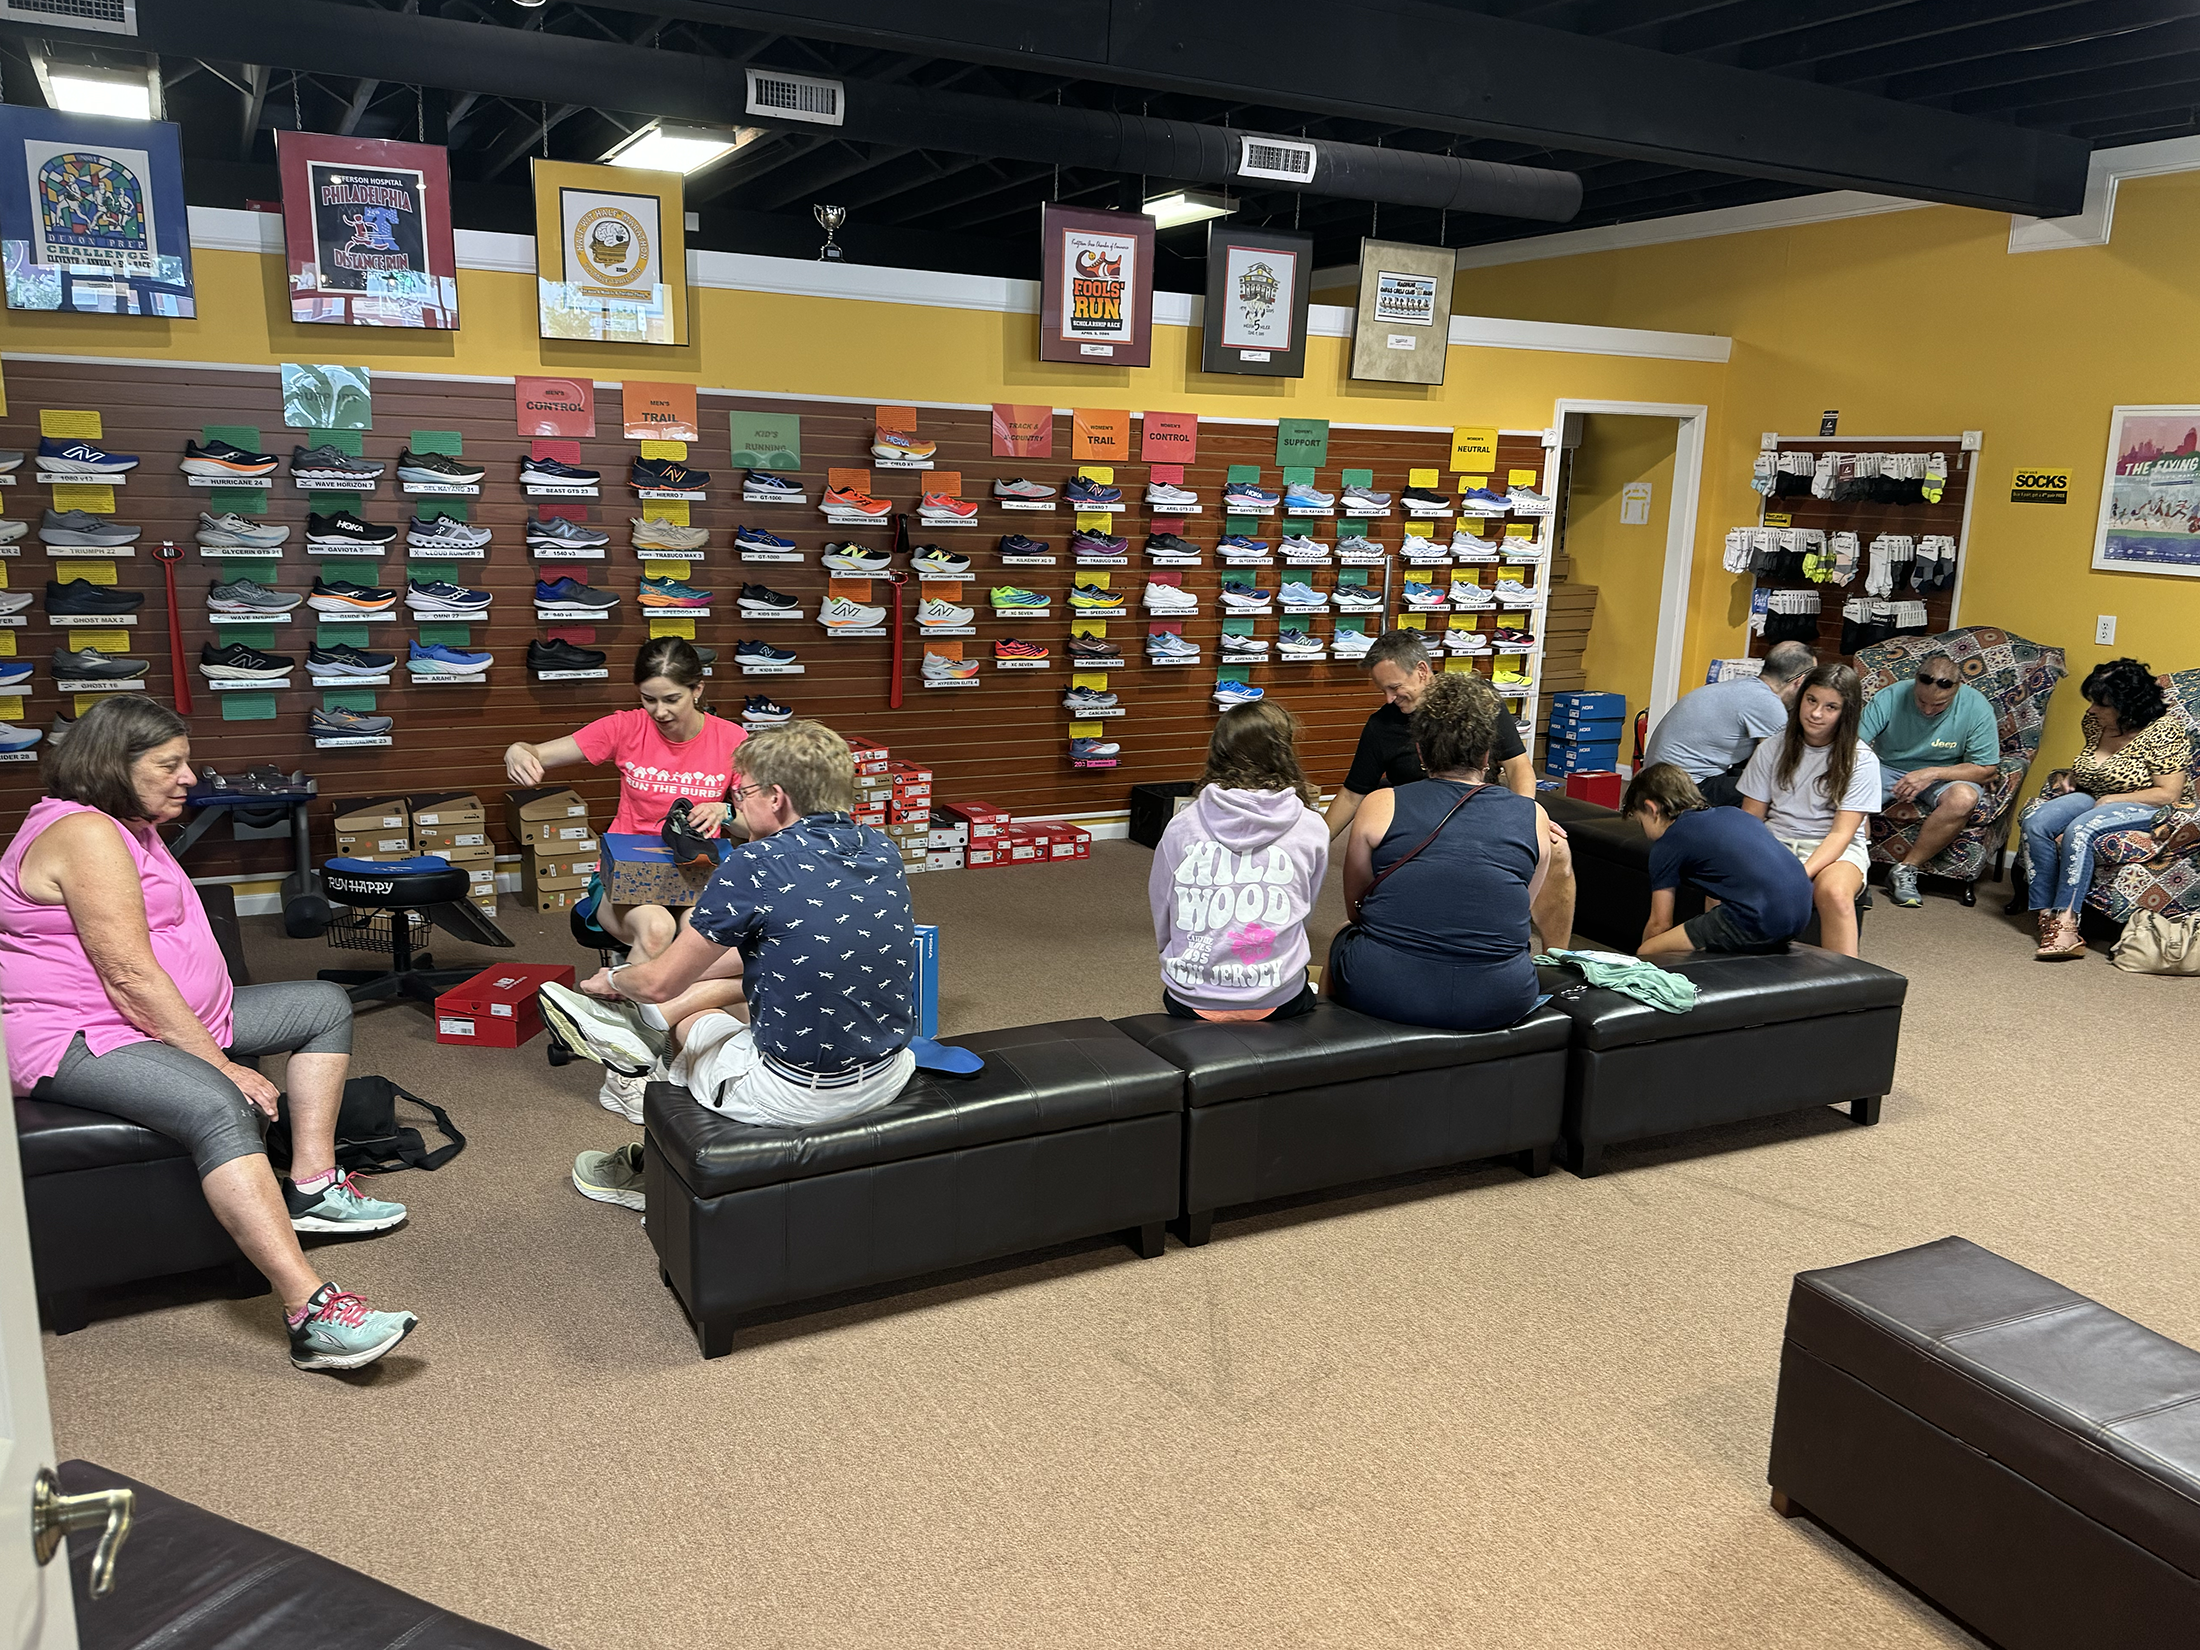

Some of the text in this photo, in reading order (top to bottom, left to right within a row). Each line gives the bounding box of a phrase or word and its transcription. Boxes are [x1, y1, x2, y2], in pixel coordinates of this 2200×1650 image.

[370, 177, 404, 187] HOSPITAL
[321, 184, 414, 214] PHILADELPHIA
[48, 233, 96, 246] DEVON
[622, 213, 649, 260] MARATHON
[46, 245, 150, 261] CHALLENGE
[333, 248, 410, 272] DISTANCE RUN
[1074, 296, 1120, 320] RUN
[1073, 320, 1107, 328] SCHOLARSHIP
[1254, 318, 1260, 331] 5
[526, 401, 585, 412] CONTROL
[641, 412, 679, 423] TRAIL
[754, 430, 779, 438] KID'S
[1149, 432, 1190, 442] CONTROL
[885, 434, 911, 448] HOKA
[1087, 436, 1116, 445] TRAIL
[1283, 438, 1321, 447] SUPPORT
[744, 443, 787, 452] RUNNING
[1457, 445, 1491, 453] NEUTRAL
[2125, 457, 2199, 476] THE FLYING
[210, 479, 253, 487] HURRICANE
[336, 481, 368, 489] HORIZON
[2014, 474, 2068, 489] SOCKS
[1245, 488, 1264, 500] HOKA
[336, 519, 366, 533] HOKA
[1581, 704, 1595, 712] HOKA
[1578, 746, 1592, 754] HOKA
[1931, 738, 1958, 750] Jeep
[625, 777, 723, 799] RUN THE BURBS
[1173, 840, 1295, 887] WILD
[327, 875, 395, 896] RUN HAPPY
[1173, 883, 1292, 933] WOOD
[1165, 956, 1285, 989] NEW JERSEY
